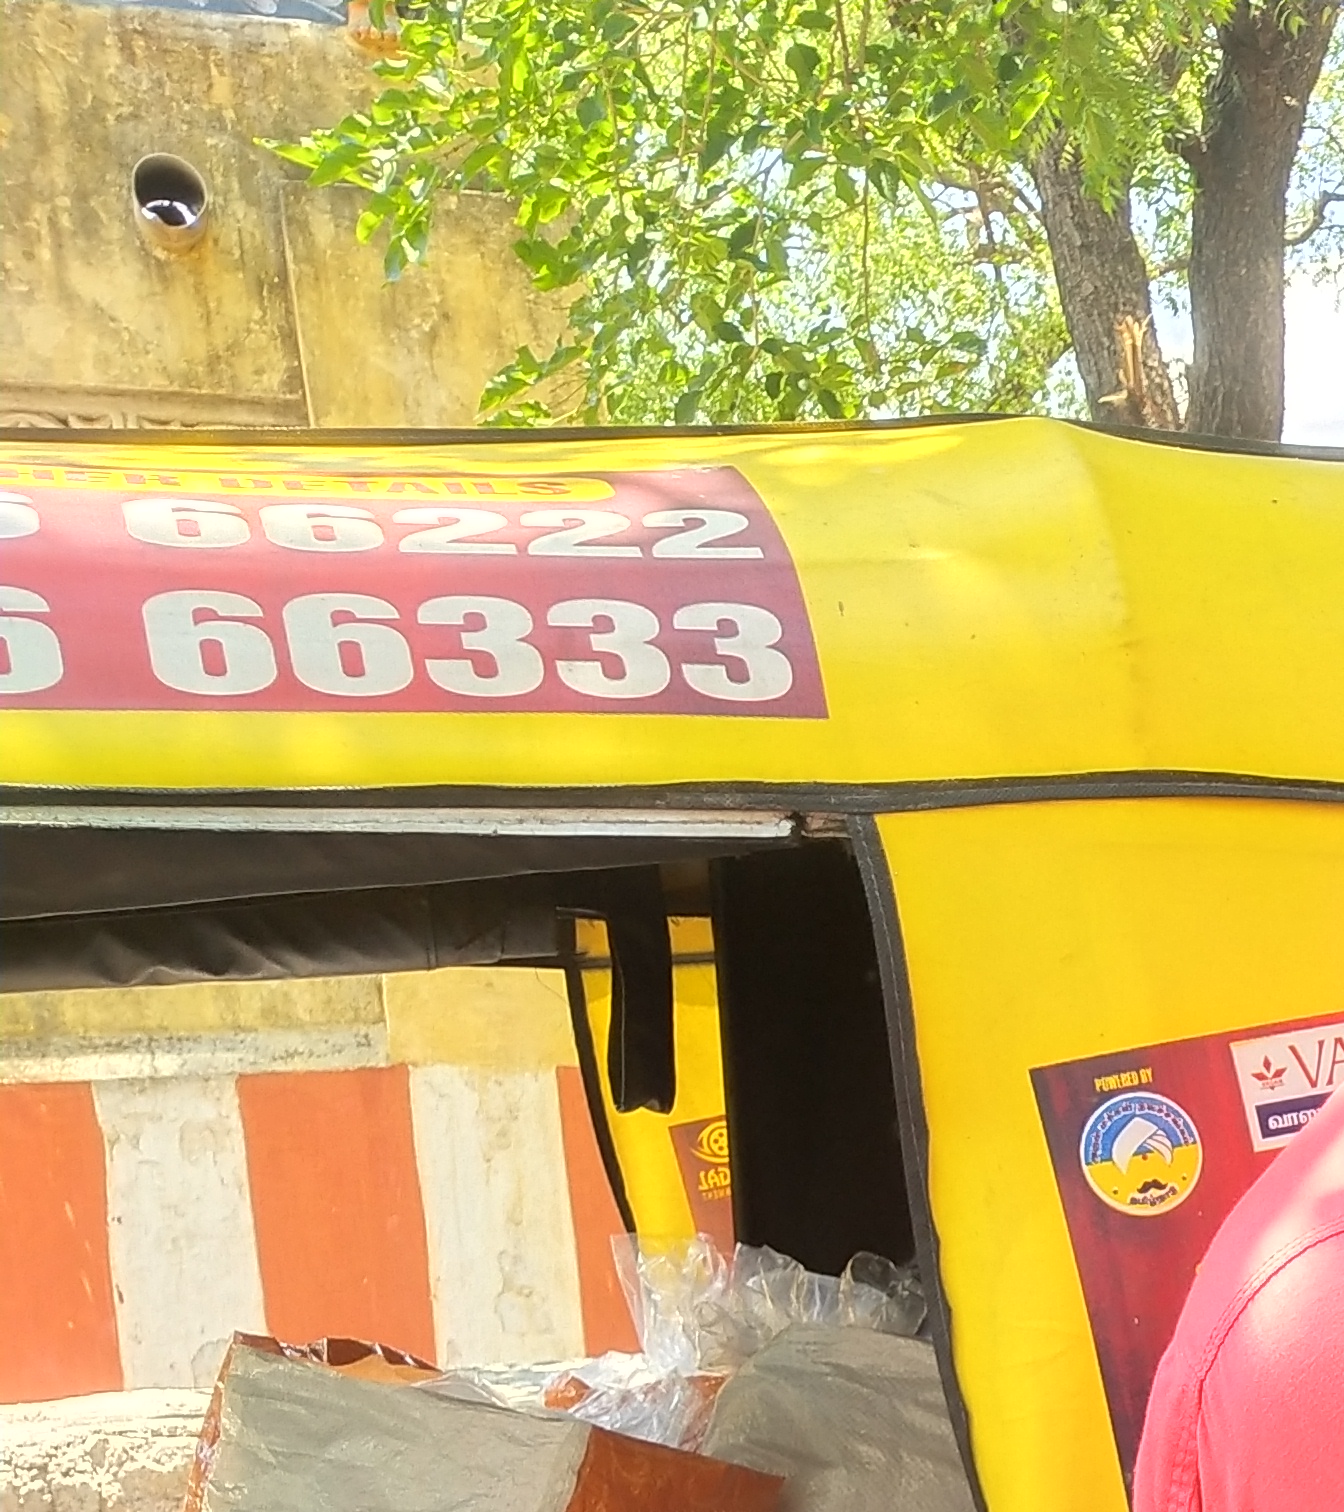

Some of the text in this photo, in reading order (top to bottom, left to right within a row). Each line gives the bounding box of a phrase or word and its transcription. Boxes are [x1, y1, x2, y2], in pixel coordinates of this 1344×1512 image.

[219, 477, 571, 496] DETAILS
[122, 497, 765, 560] 66222
[142, 589, 794, 701] 66333
[1094, 1070, 1139, 1092] POWERED
